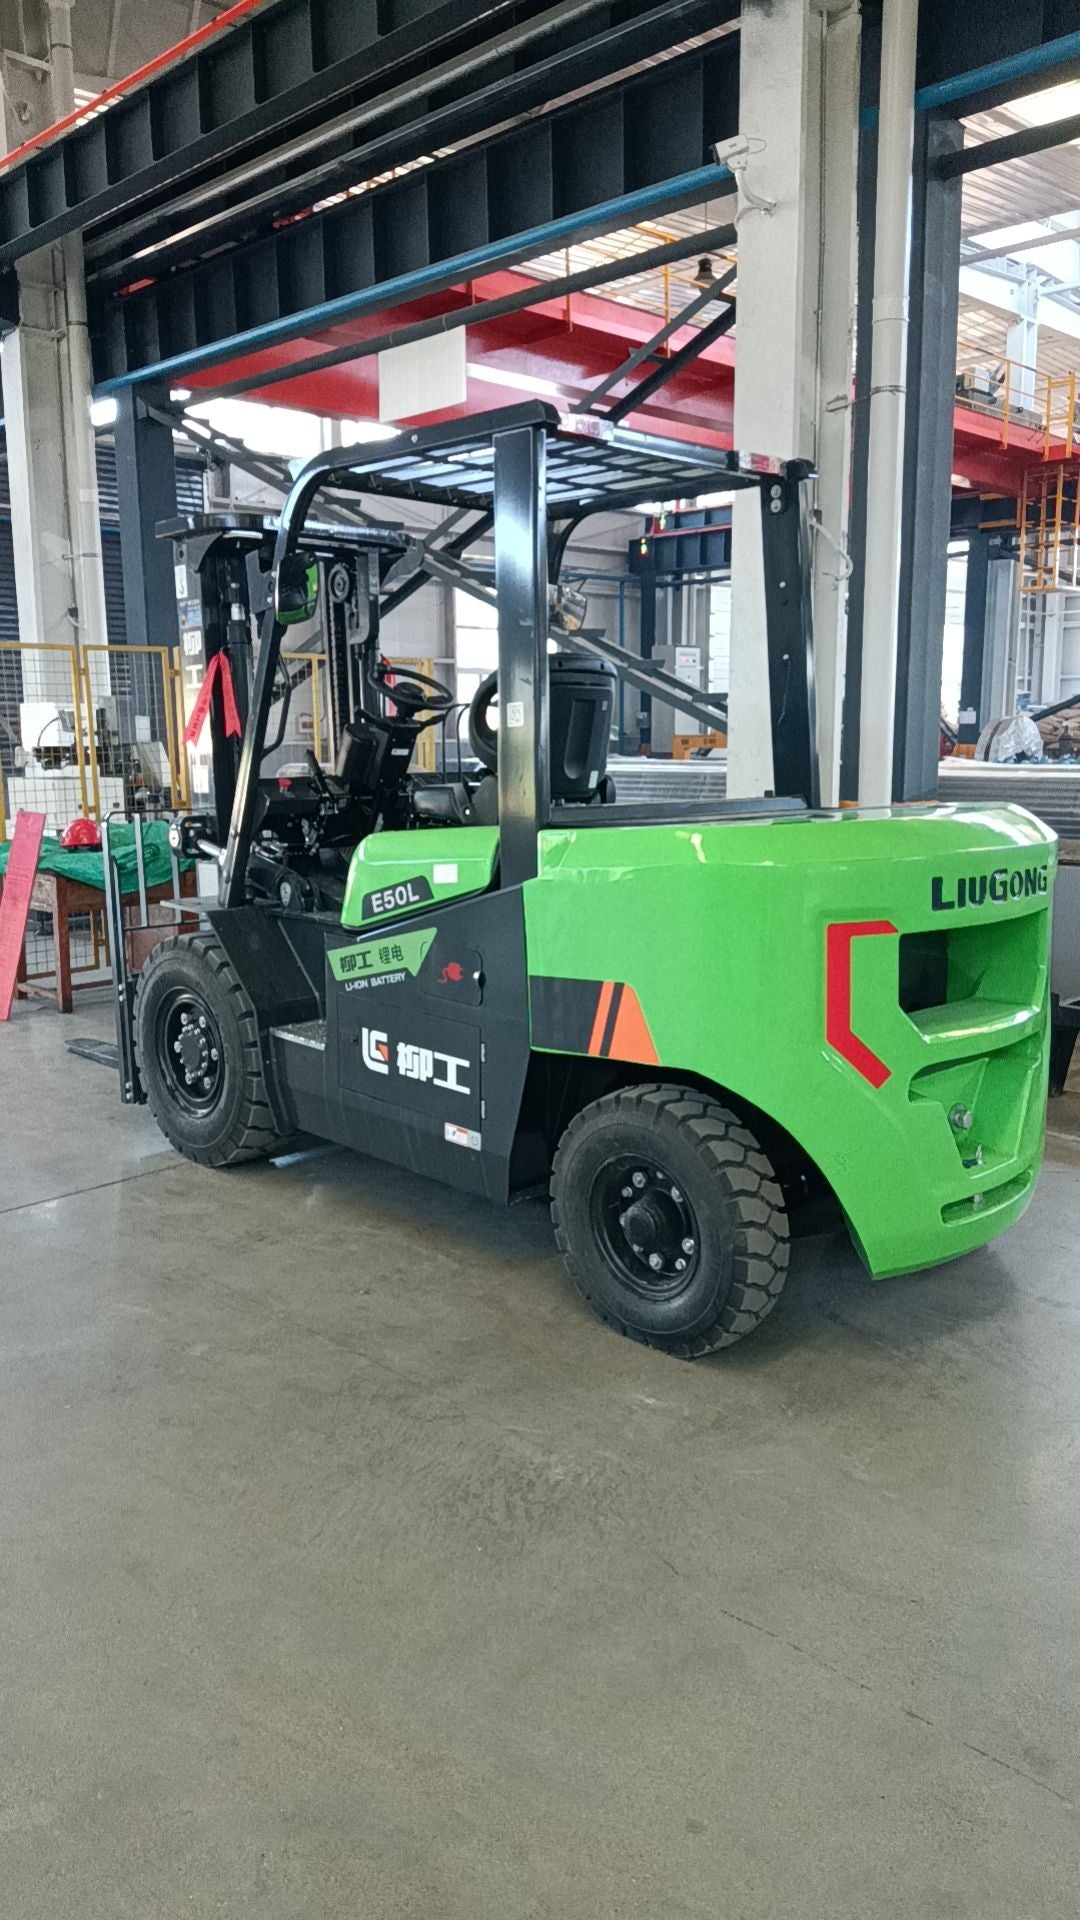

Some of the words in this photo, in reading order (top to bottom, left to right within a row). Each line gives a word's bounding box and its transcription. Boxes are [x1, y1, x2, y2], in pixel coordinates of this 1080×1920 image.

[371, 883, 420, 913] E50L
[931, 864, 1048, 912] LIUGONG
[340, 950, 373, 973] 柳工
[379, 944, 404, 965] 锂电
[345, 979, 369, 992] LI-ION
[370, 972, 406, 987] BATTERY
[396, 1041, 471, 1095] 柳工
